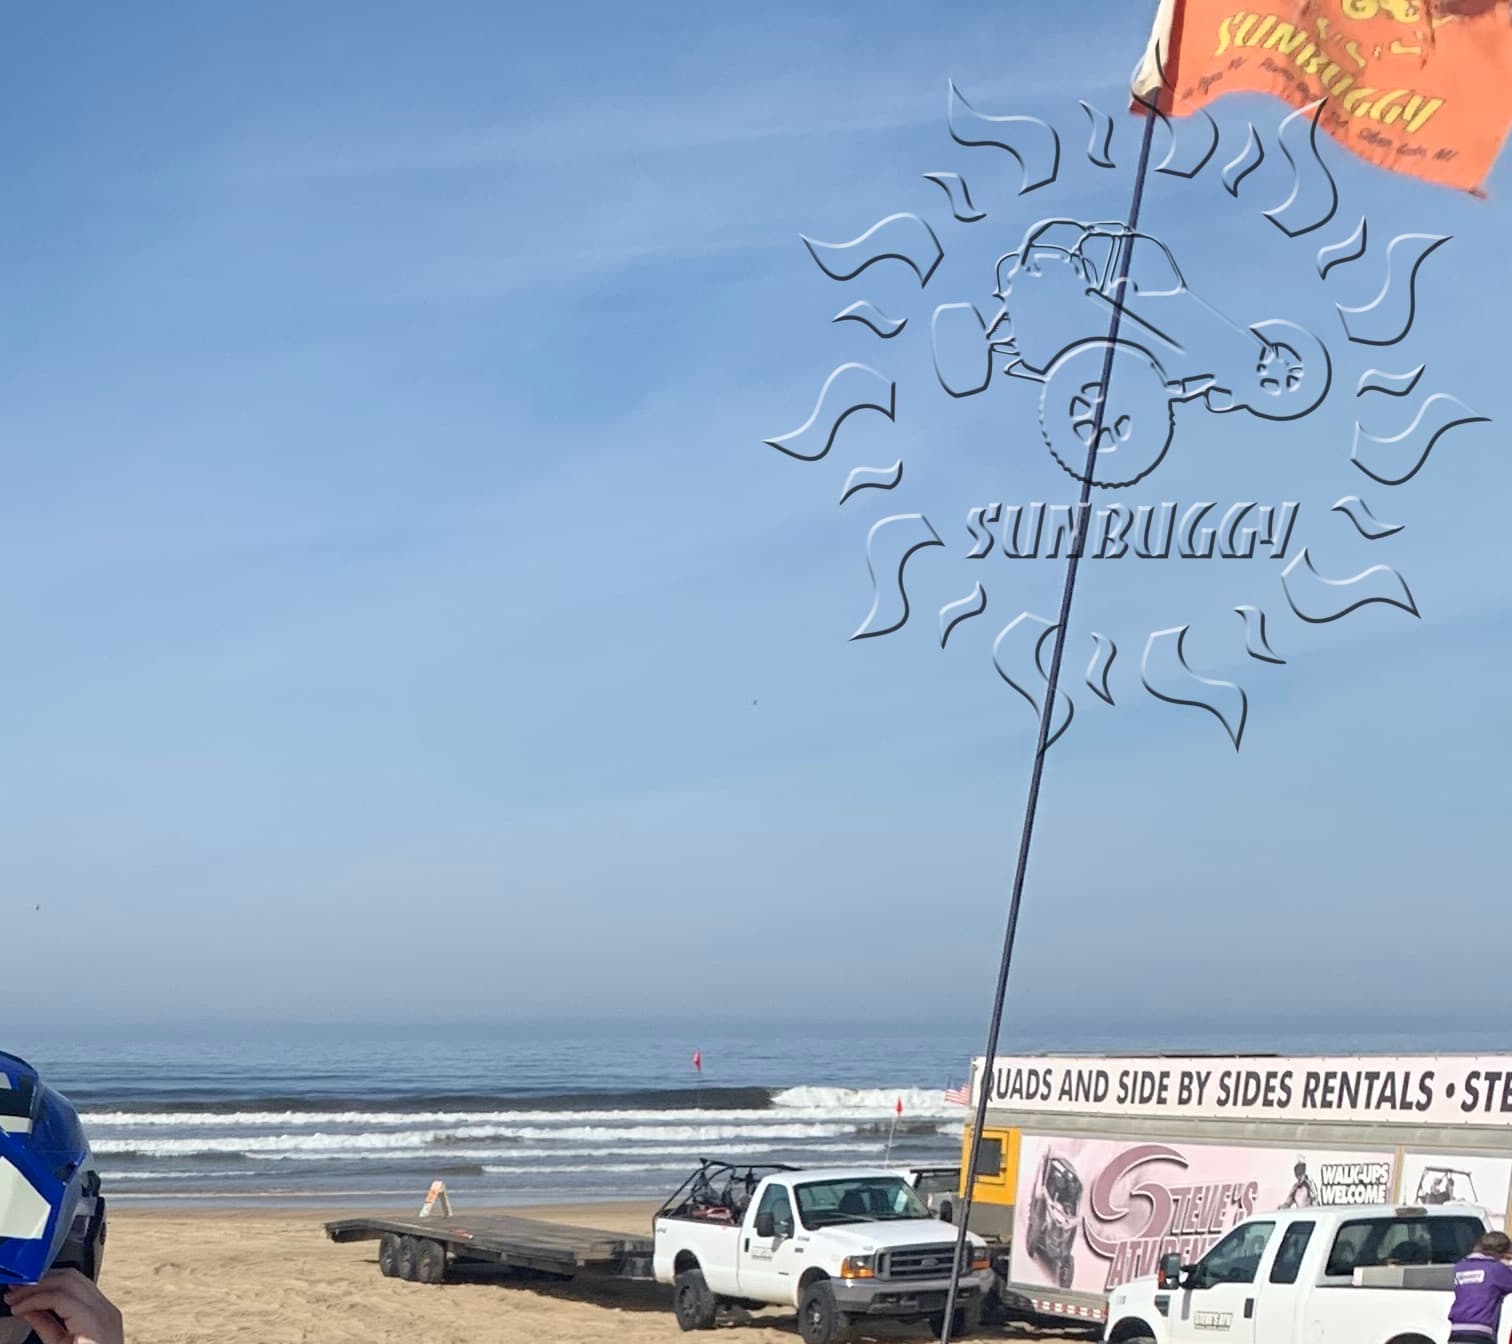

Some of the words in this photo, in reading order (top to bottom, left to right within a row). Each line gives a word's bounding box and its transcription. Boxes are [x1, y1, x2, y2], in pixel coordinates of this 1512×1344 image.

[1214, 10, 1445, 134] SUNBUGGY
[1058, 1069, 1109, 1102] AND
[1117, 1070, 1170, 1104] SIDE
[1177, 1071, 1212, 1106] BY
[1216, 1070, 1293, 1108] SIDES
[1302, 1071, 1435, 1111] RENTALS
[1321, 1163, 1390, 1185] WALK-UPS
[1320, 1184, 1387, 1206] WELCOME
